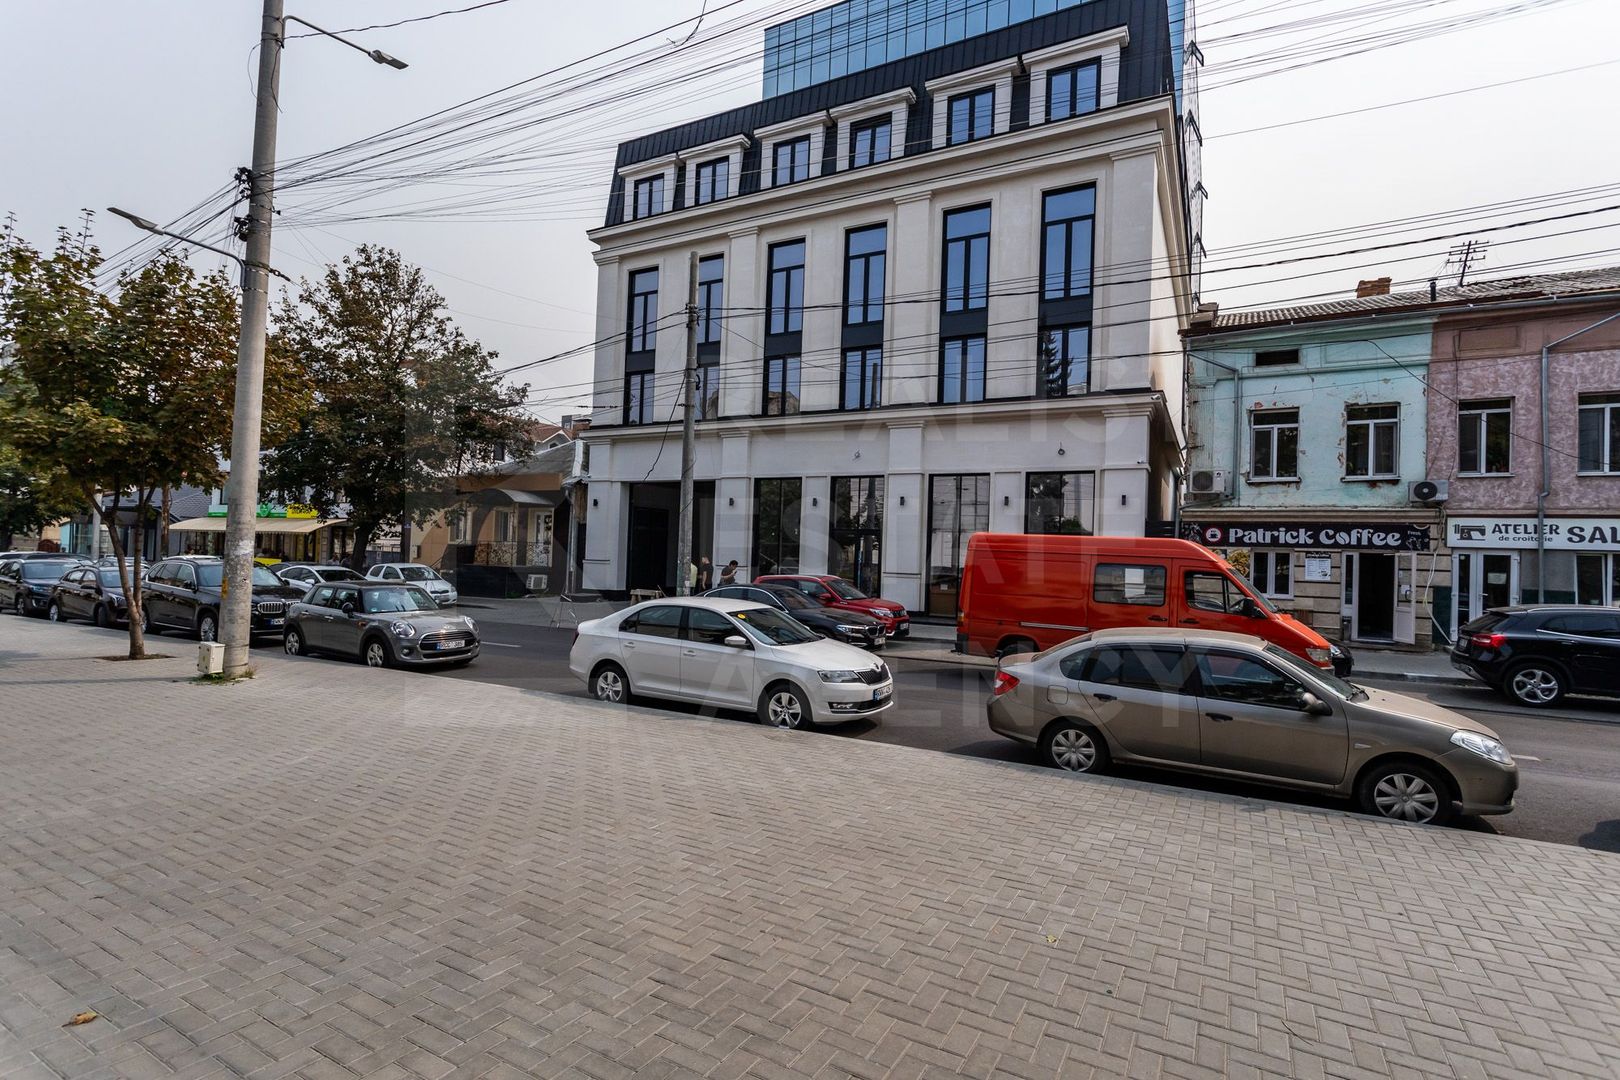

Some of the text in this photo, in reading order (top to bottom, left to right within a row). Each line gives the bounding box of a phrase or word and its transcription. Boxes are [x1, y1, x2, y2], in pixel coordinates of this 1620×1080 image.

[1229, 527, 1402, 547] Patrick Coffee
[1491, 523, 1561, 535] ATELIER
